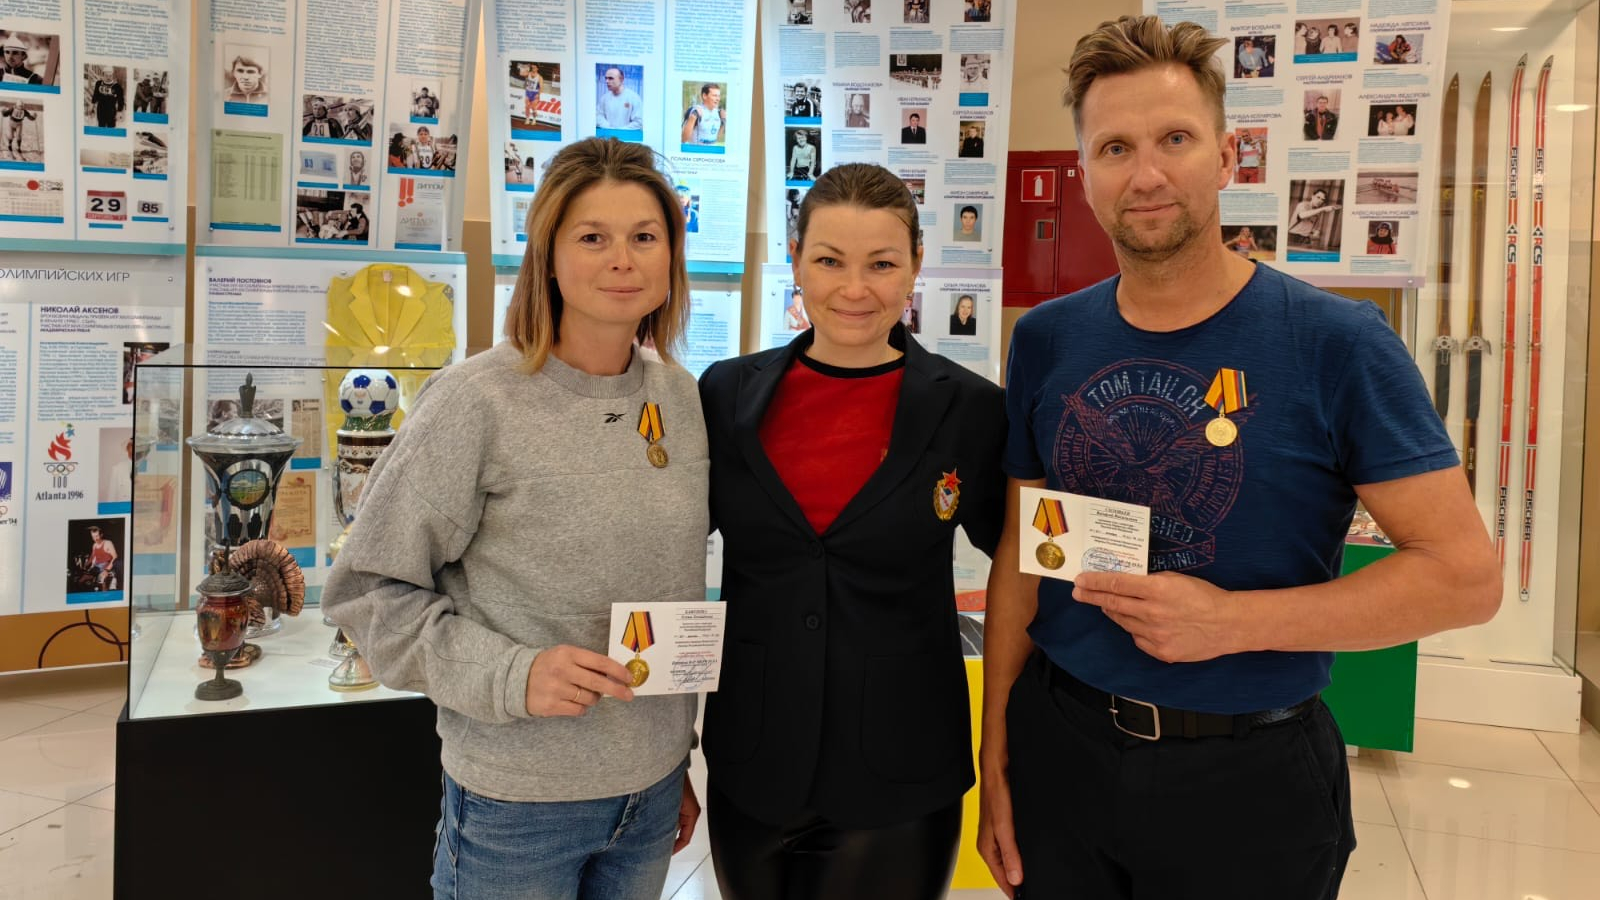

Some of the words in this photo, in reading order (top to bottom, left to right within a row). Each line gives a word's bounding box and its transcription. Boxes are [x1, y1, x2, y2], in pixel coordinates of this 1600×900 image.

[1509, 146, 1518, 200] FISCHER
[90, 197, 121, 212] 29
[141, 202, 159, 214] 85
[1507, 235, 1517, 263] RCS
[1533, 237, 1543, 265] RCS
[0, 268, 104, 282] ОЛИМПИЙСКИХ
[106, 271, 131, 283] ИГР
[40, 305, 80, 314] НИКОЛАЙ
[82, 306, 119, 314] АКСЕНОВ
[1087, 371, 1132, 408] TOM
[1136, 370, 1207, 419] TAILOR
[35, 491, 67, 501] Atlanta
[68, 491, 84, 500] 1996
[1498, 486, 1507, 538] FISCHER
[1524, 489, 1533, 541] FISCHER
